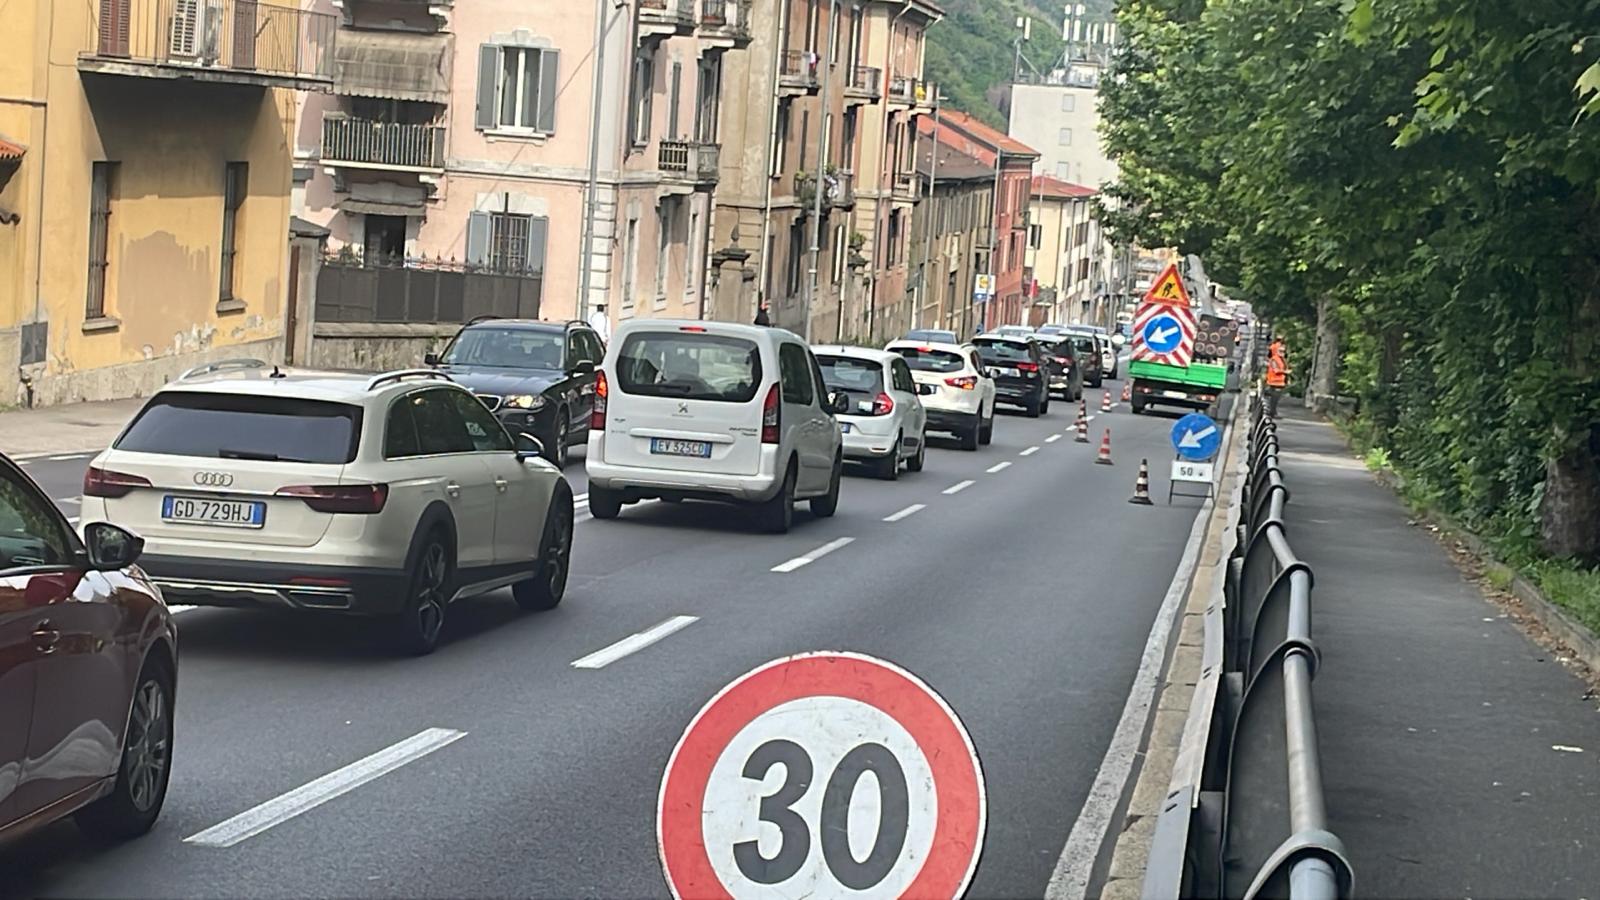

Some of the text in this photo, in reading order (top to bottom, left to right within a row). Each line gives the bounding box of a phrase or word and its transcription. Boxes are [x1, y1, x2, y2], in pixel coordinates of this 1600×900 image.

[1180, 466, 1193, 477] 50
[174, 500, 252, 522] GD 729HJ
[732, 738, 909, 890] 30
